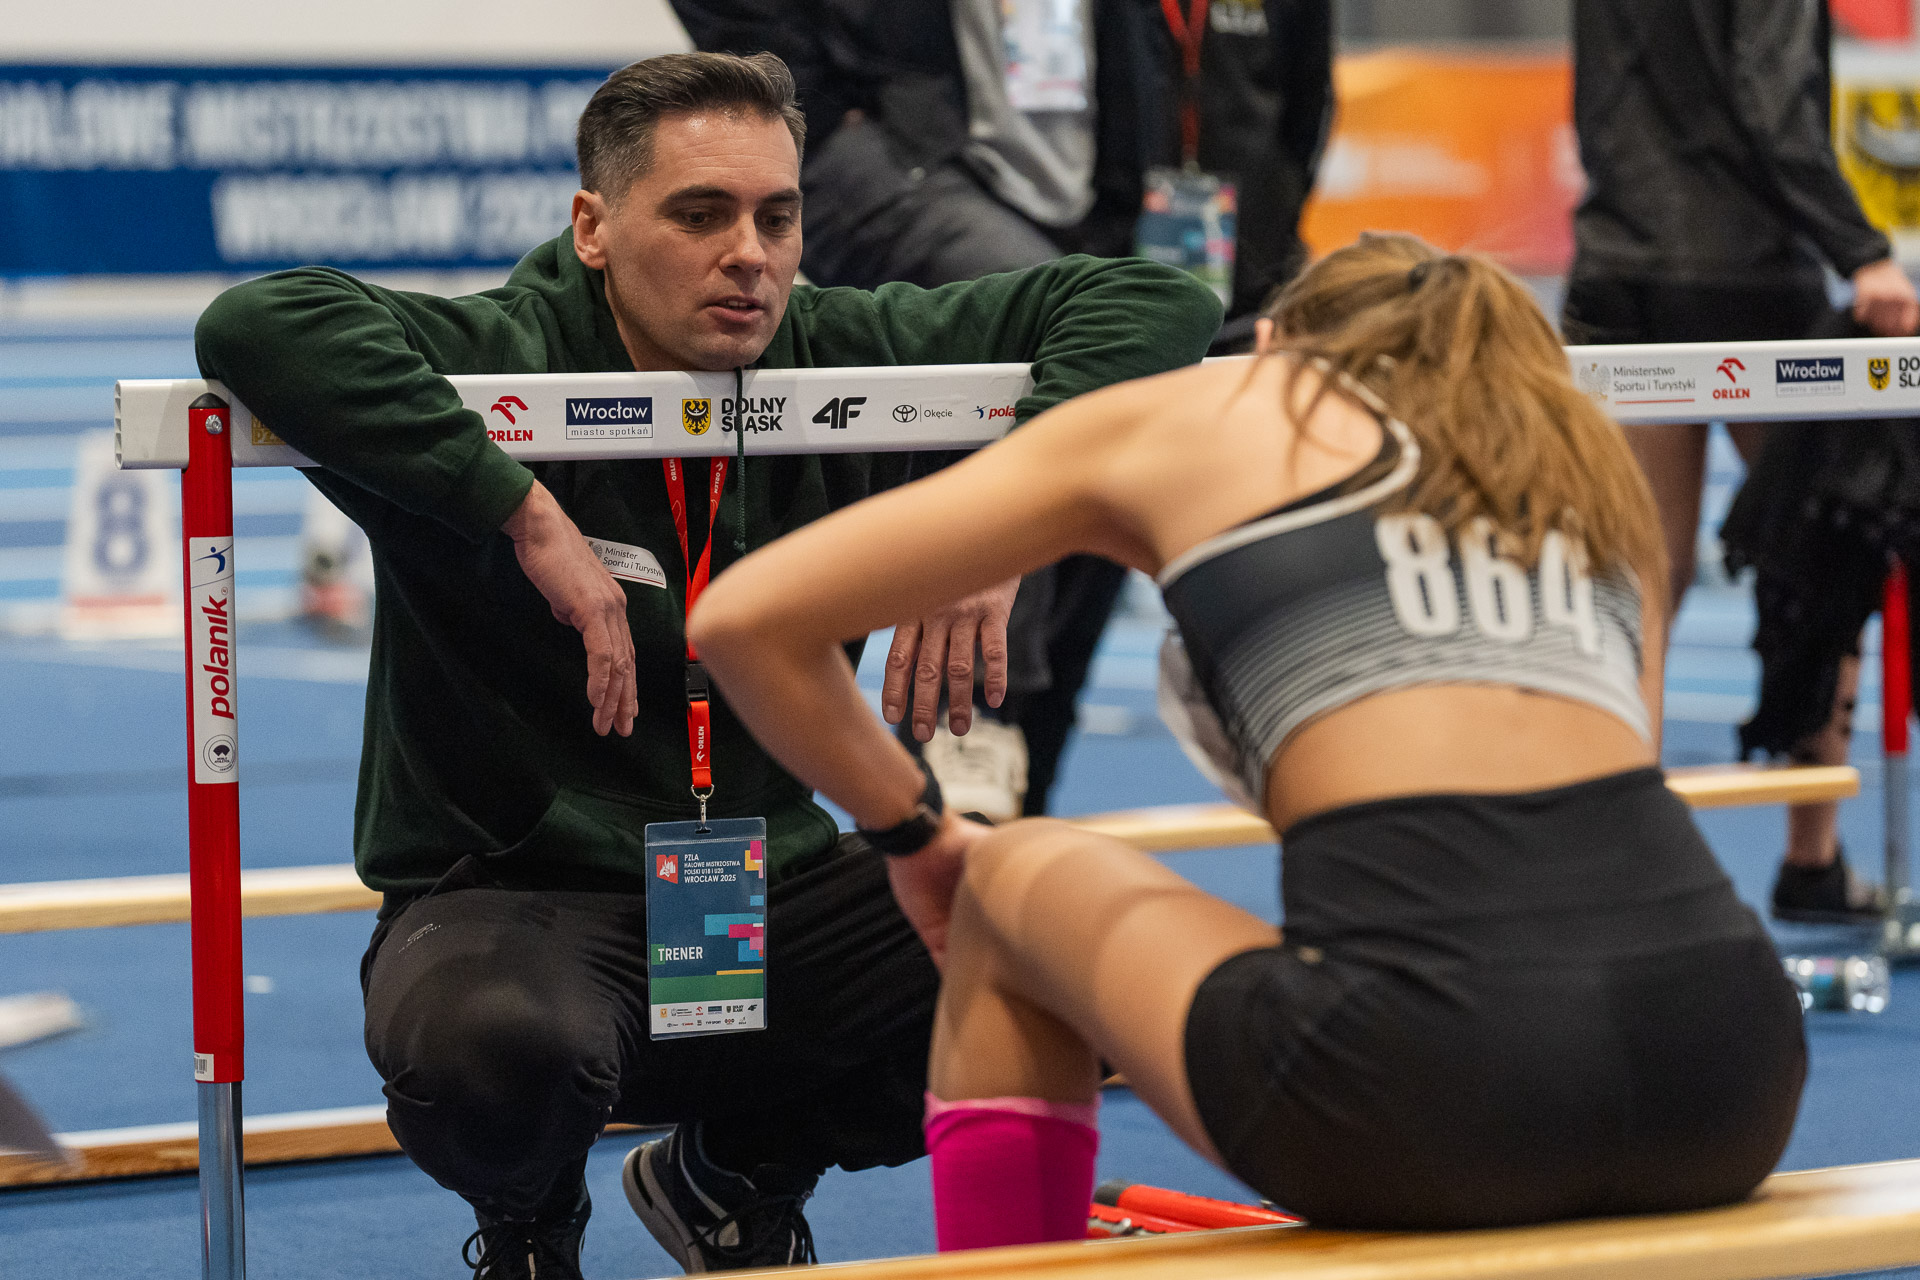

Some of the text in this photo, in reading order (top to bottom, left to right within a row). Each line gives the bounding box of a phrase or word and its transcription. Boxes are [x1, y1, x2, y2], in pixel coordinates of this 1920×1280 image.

[1613, 365, 1676, 377] Ministerstwo
[1899, 357, 1920, 371] DO
[1613, 381, 1646, 393] Sportu
[1654, 378, 1696, 392] Turystyki
[1899, 372, 1920, 388] ŚL
[1712, 388, 1750, 400] ORLEN
[570, 400, 648, 420] Wrocław
[721, 397, 787, 414] DOLNY
[812, 396, 867, 430] 4F
[924, 409, 953, 420] Okęcie
[988, 405, 1016, 421] pola
[487, 430, 533, 441] ORLEN
[571, 426, 649, 437] miasto spotkań
[94, 472, 150, 579] 8
[605, 547, 638, 560] Minister
[602, 556, 630, 569] Sportu
[1375, 512, 1601, 656] 864
[201, 594, 235, 720] polanik
[684, 853, 699, 861] PZLA
[705, 860, 740, 868] MISTRZOSTWA
[684, 874, 737, 883] WROCŁAW 2025
[657, 946, 703, 961] TRENER
